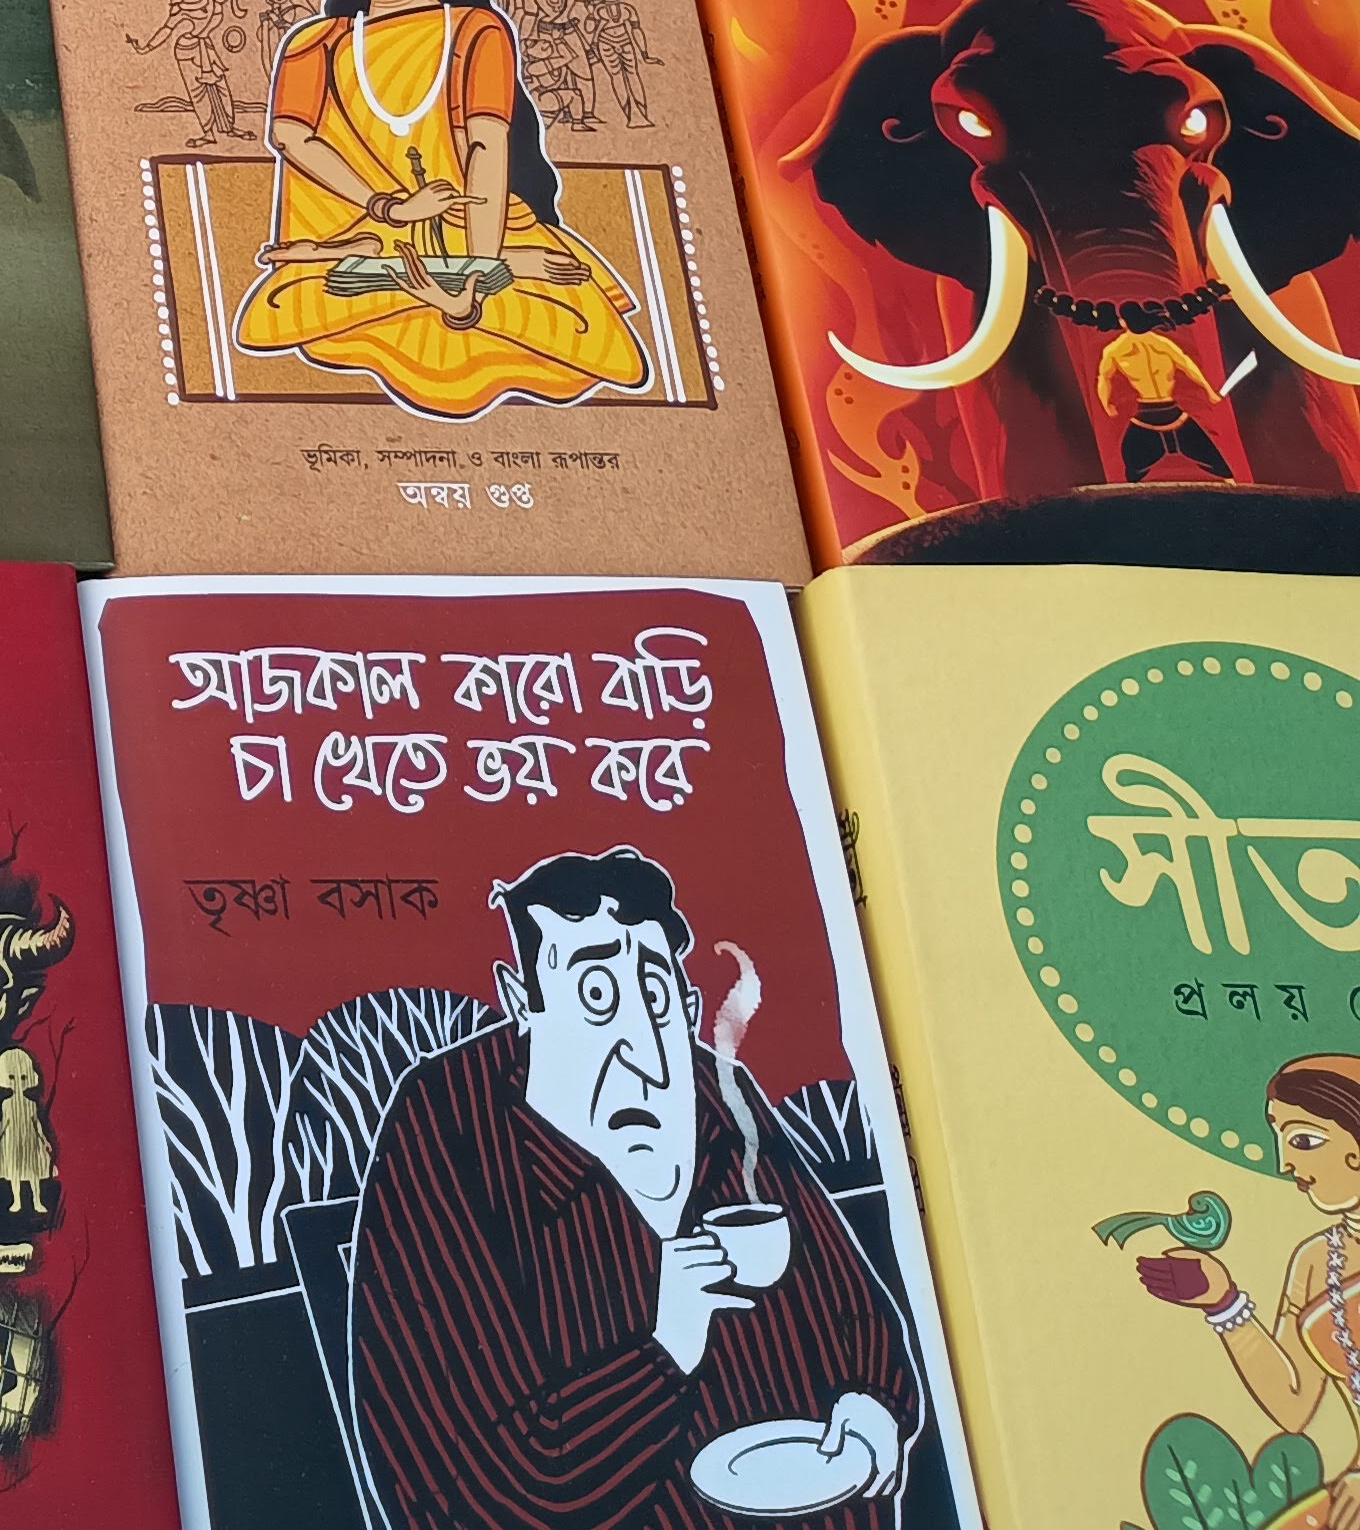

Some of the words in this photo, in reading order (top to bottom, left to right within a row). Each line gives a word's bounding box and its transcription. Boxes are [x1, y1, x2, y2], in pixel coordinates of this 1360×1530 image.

[300, 444, 368, 472] ভূমিকা,
[376, 449, 457, 469] সম্পাদনা
[468, 453, 483, 468] ও
[491, 450, 541, 469] বাংলা
[551, 451, 620, 471] রূপান্তর
[397, 481, 471, 510] অন্বয়
[485, 481, 534, 510] গুপ্ত
[168, 646, 426, 723] আজকাল
[441, 652, 583, 724] কারো
[592, 627, 713, 729] বাড়ি
[229, 735, 293, 802] চা
[314, 731, 448, 813] খেতে
[463, 735, 577, 804] ভয়
[585, 738, 711, 812] করে
[184, 873, 291, 938] তৃষ্ণা
[310, 873, 439, 921] বসাক
